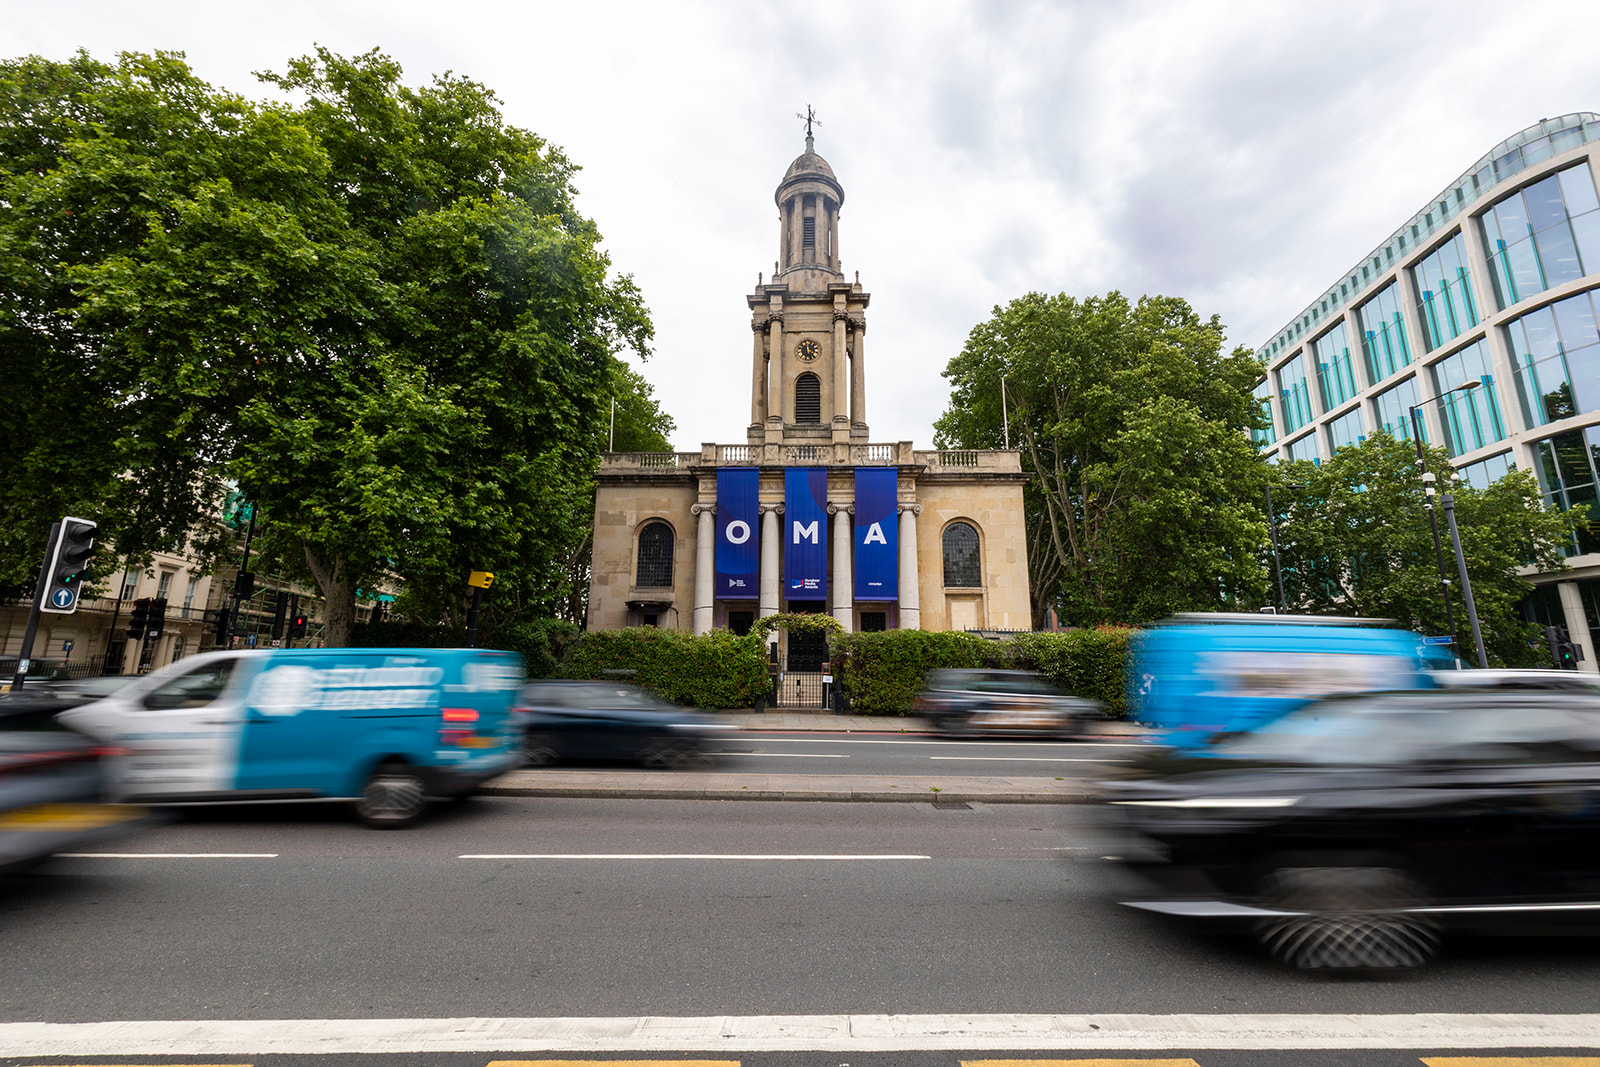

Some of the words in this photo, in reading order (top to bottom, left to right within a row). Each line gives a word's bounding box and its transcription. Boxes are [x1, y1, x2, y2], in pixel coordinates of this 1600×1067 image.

[726, 520, 750, 544] O
[793, 521, 818, 544] M
[863, 521, 887, 544] A
